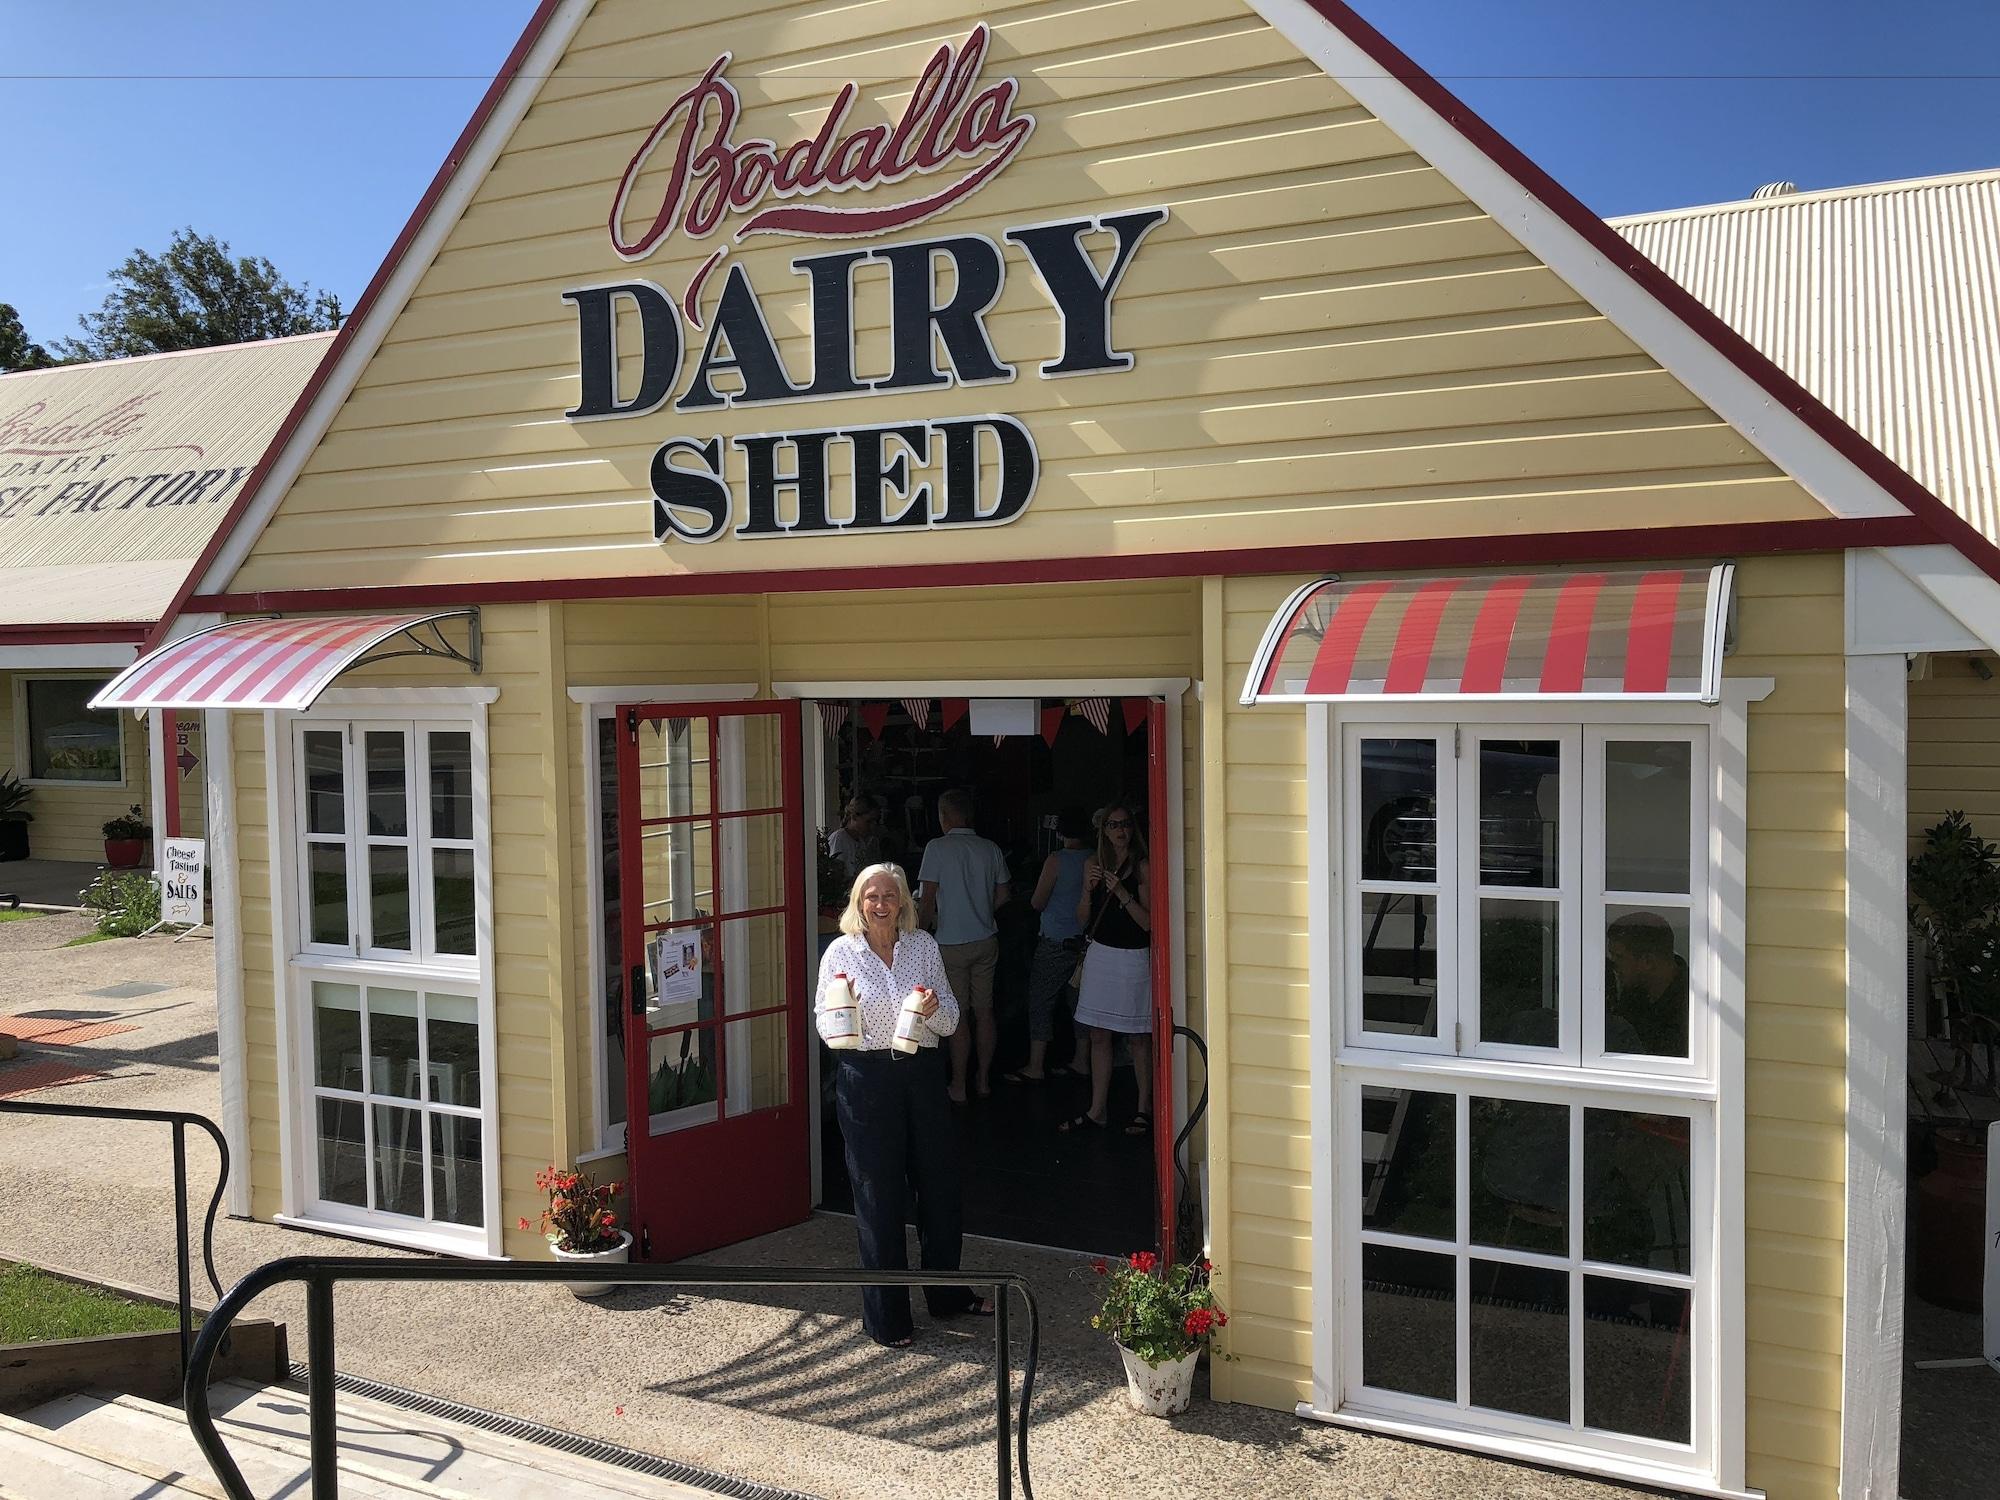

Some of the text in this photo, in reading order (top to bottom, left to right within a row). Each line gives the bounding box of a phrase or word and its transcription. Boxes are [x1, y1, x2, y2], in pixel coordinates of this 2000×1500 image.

[607, 20, 1036, 260] Bodalla
[560, 204, 1170, 422] DAIRY
[33, 465, 258, 516] FACTORY
[649, 412, 1041, 544] SHED
[166, 845, 196, 860] Cheese
[169, 859, 200, 873] Tasting
[177, 872, 188, 884] &
